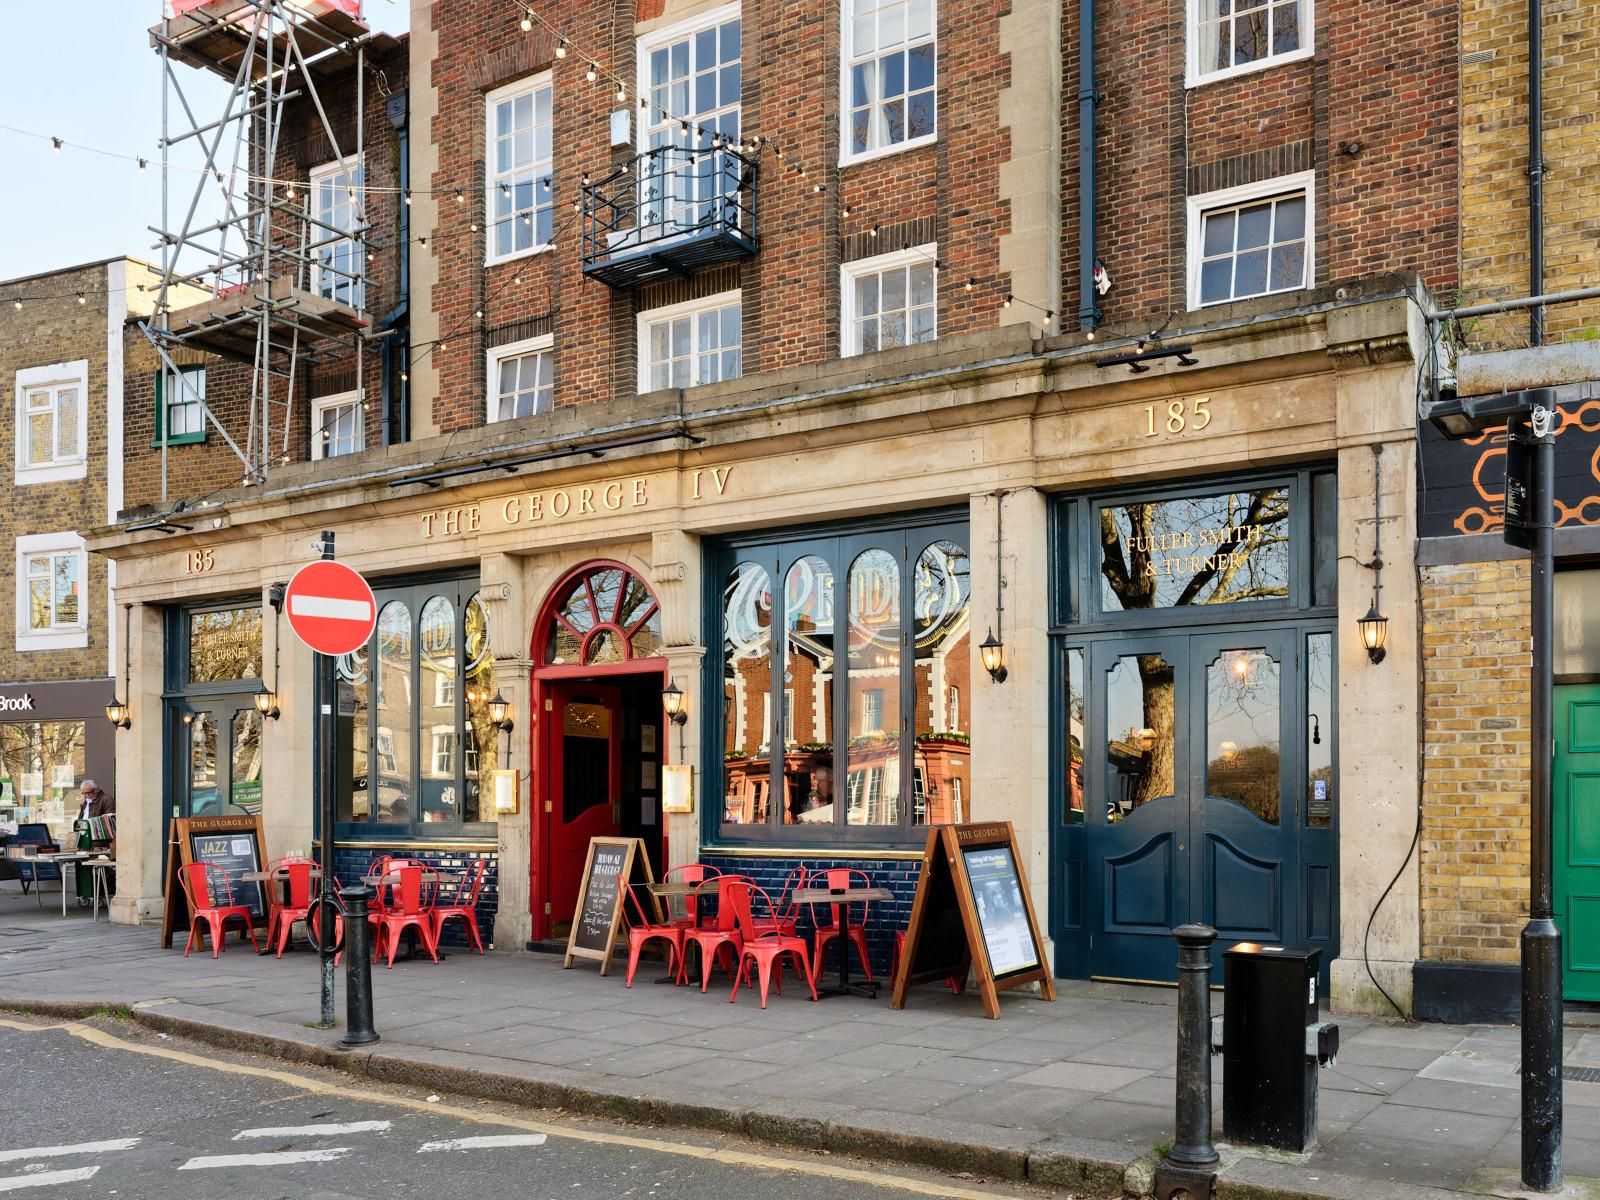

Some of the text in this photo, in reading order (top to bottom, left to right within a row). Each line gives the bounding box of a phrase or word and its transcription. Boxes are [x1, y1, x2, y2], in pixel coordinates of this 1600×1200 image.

[1144, 397, 1211, 437] 185
[421, 466, 734, 538] THE GEORGE IV
[1126, 524, 1262, 553] FULLER SMITH
[185, 549, 215, 574] 185
[1145, 552, 1242, 577] & TURNER
[214, 646, 248, 661] TURNER
[191, 820, 208, 828] THE
[210, 818, 243, 827] GEORGE
[958, 830, 973, 840] THE
[973, 828, 1000, 838] GEORGE
[201, 840, 228, 854] JAZZ
